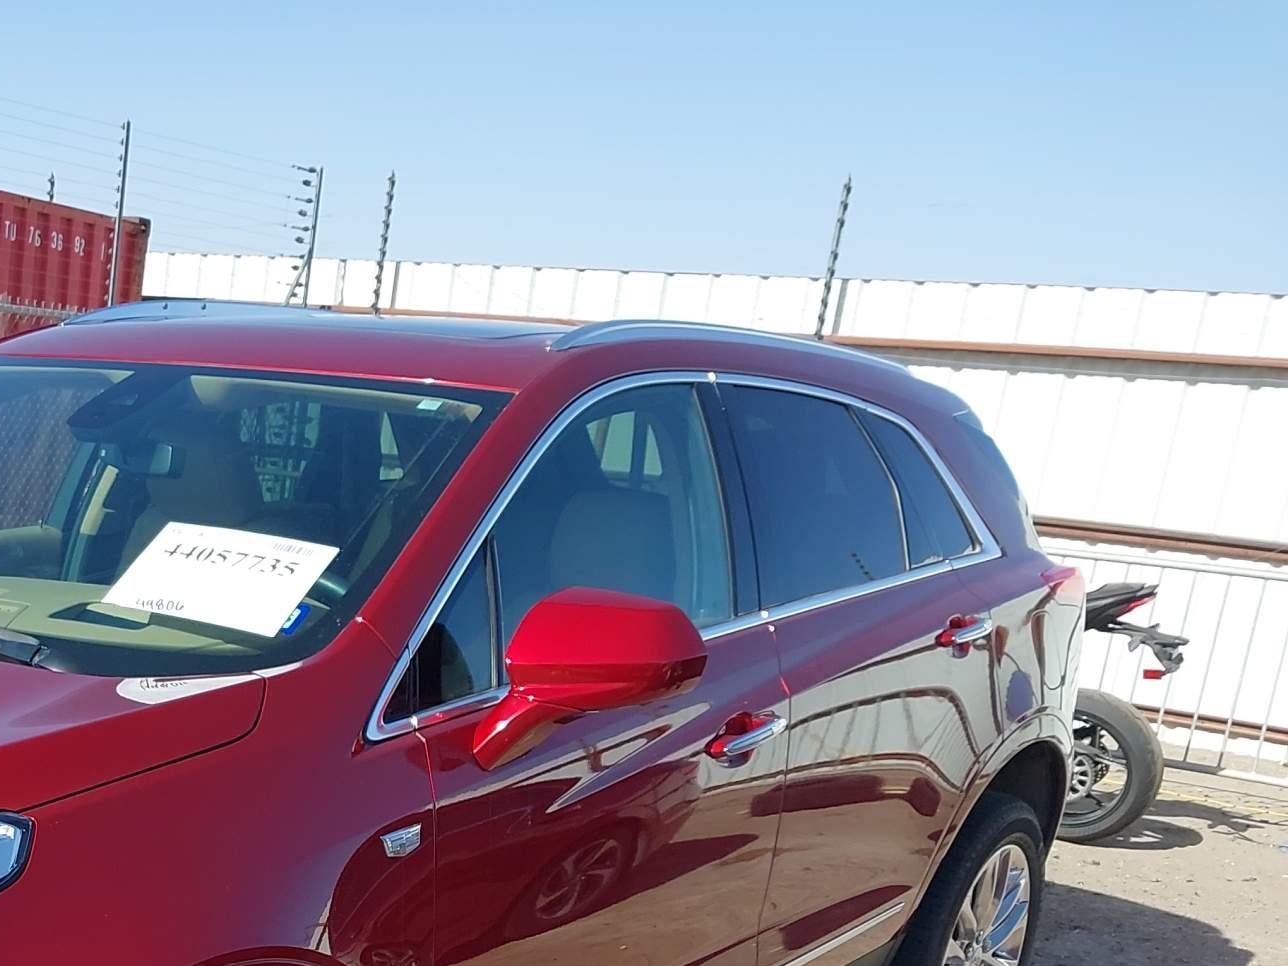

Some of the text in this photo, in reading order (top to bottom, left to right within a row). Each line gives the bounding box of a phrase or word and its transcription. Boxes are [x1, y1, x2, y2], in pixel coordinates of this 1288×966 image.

[4, 220, 17, 242] TU
[28, 226, 42, 247] 76
[164, 543, 300, 577] 44057735
